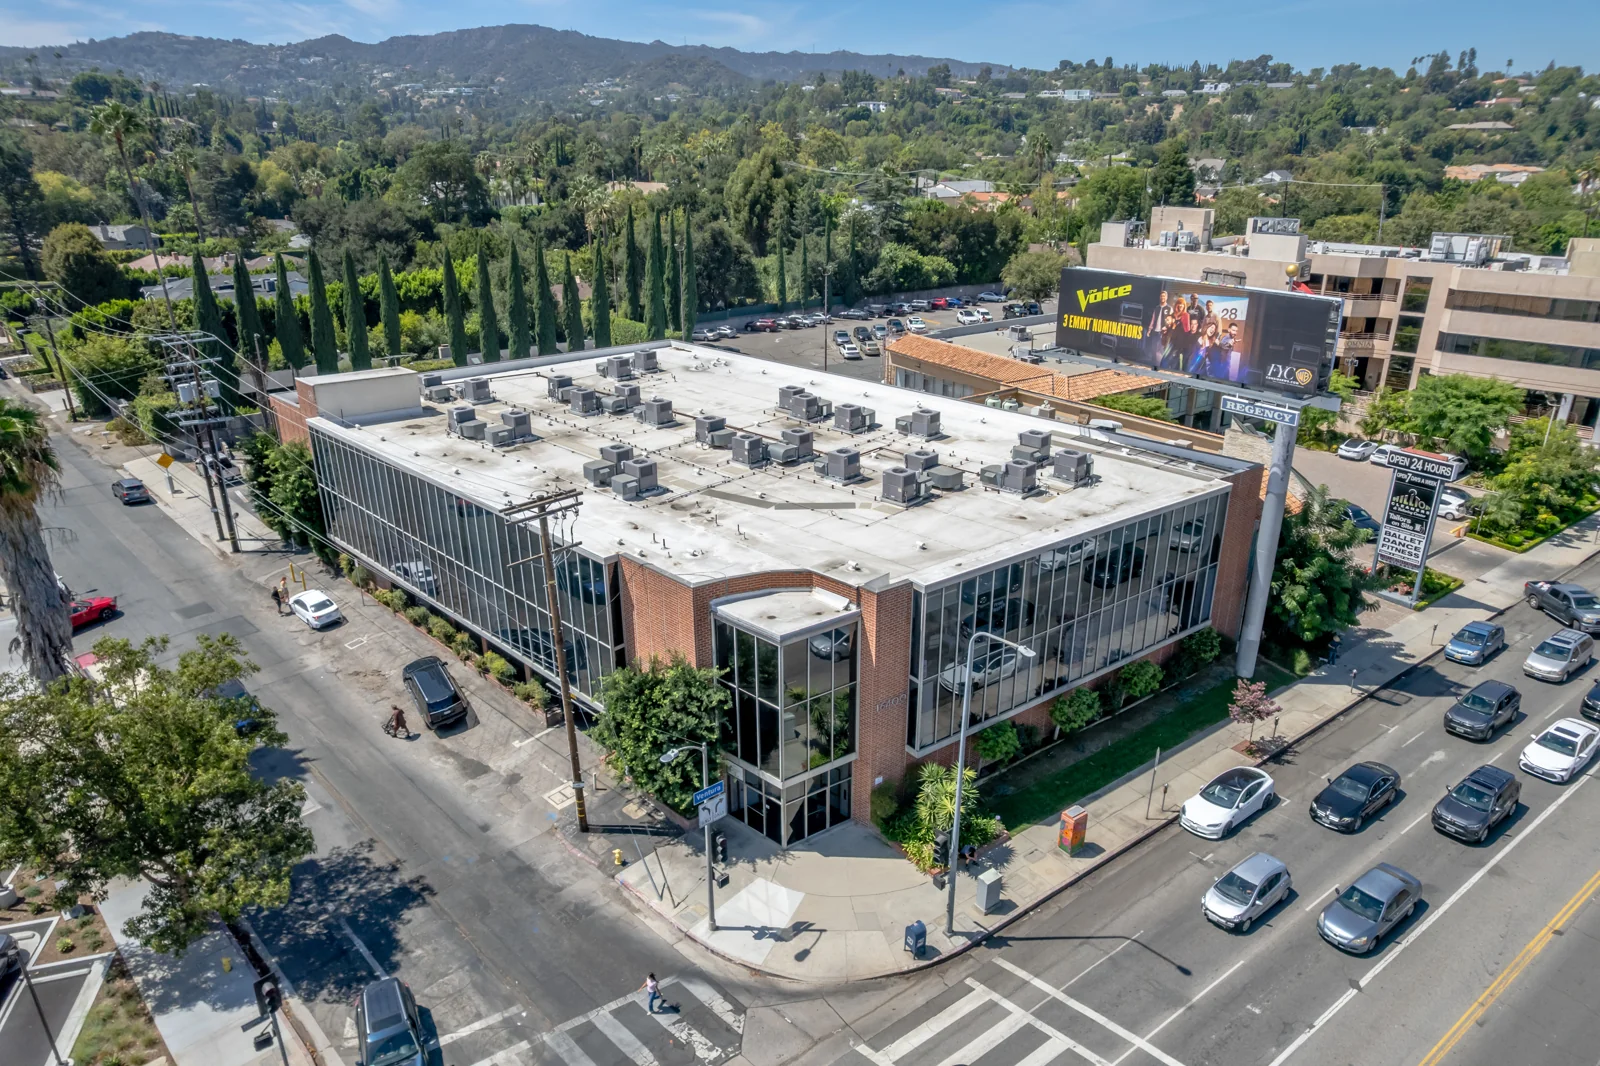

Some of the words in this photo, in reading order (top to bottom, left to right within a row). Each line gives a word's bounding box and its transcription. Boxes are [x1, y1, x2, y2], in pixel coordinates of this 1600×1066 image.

[1076, 284, 1132, 312] Voice
[1221, 308, 1238, 320] 28
[1063, 314, 1068, 327] 3
[1069, 315, 1092, 330] EMMY
[1092, 318, 1144, 340] NOMINATIONS
[1268, 364, 1296, 380] FYC
[1226, 400, 1292, 422] REGENCY
[1390, 454, 1410, 466] OPEN
[1410, 458, 1422, 471] 24
[1424, 462, 1452, 476] HOURS
[1406, 472, 1412, 482] 7
[1391, 502, 1430, 515] CLEANERS
[1392, 494, 1431, 510] HILLTOP
[1388, 512, 1412, 524] Tailors
[1400, 522, 1414, 530] Site
[1383, 537, 1422, 552] DANCE
[1384, 530, 1424, 546] BALLET
[1382, 543, 1420, 558] FITNESS
[696, 786, 721, 800] Ventura
